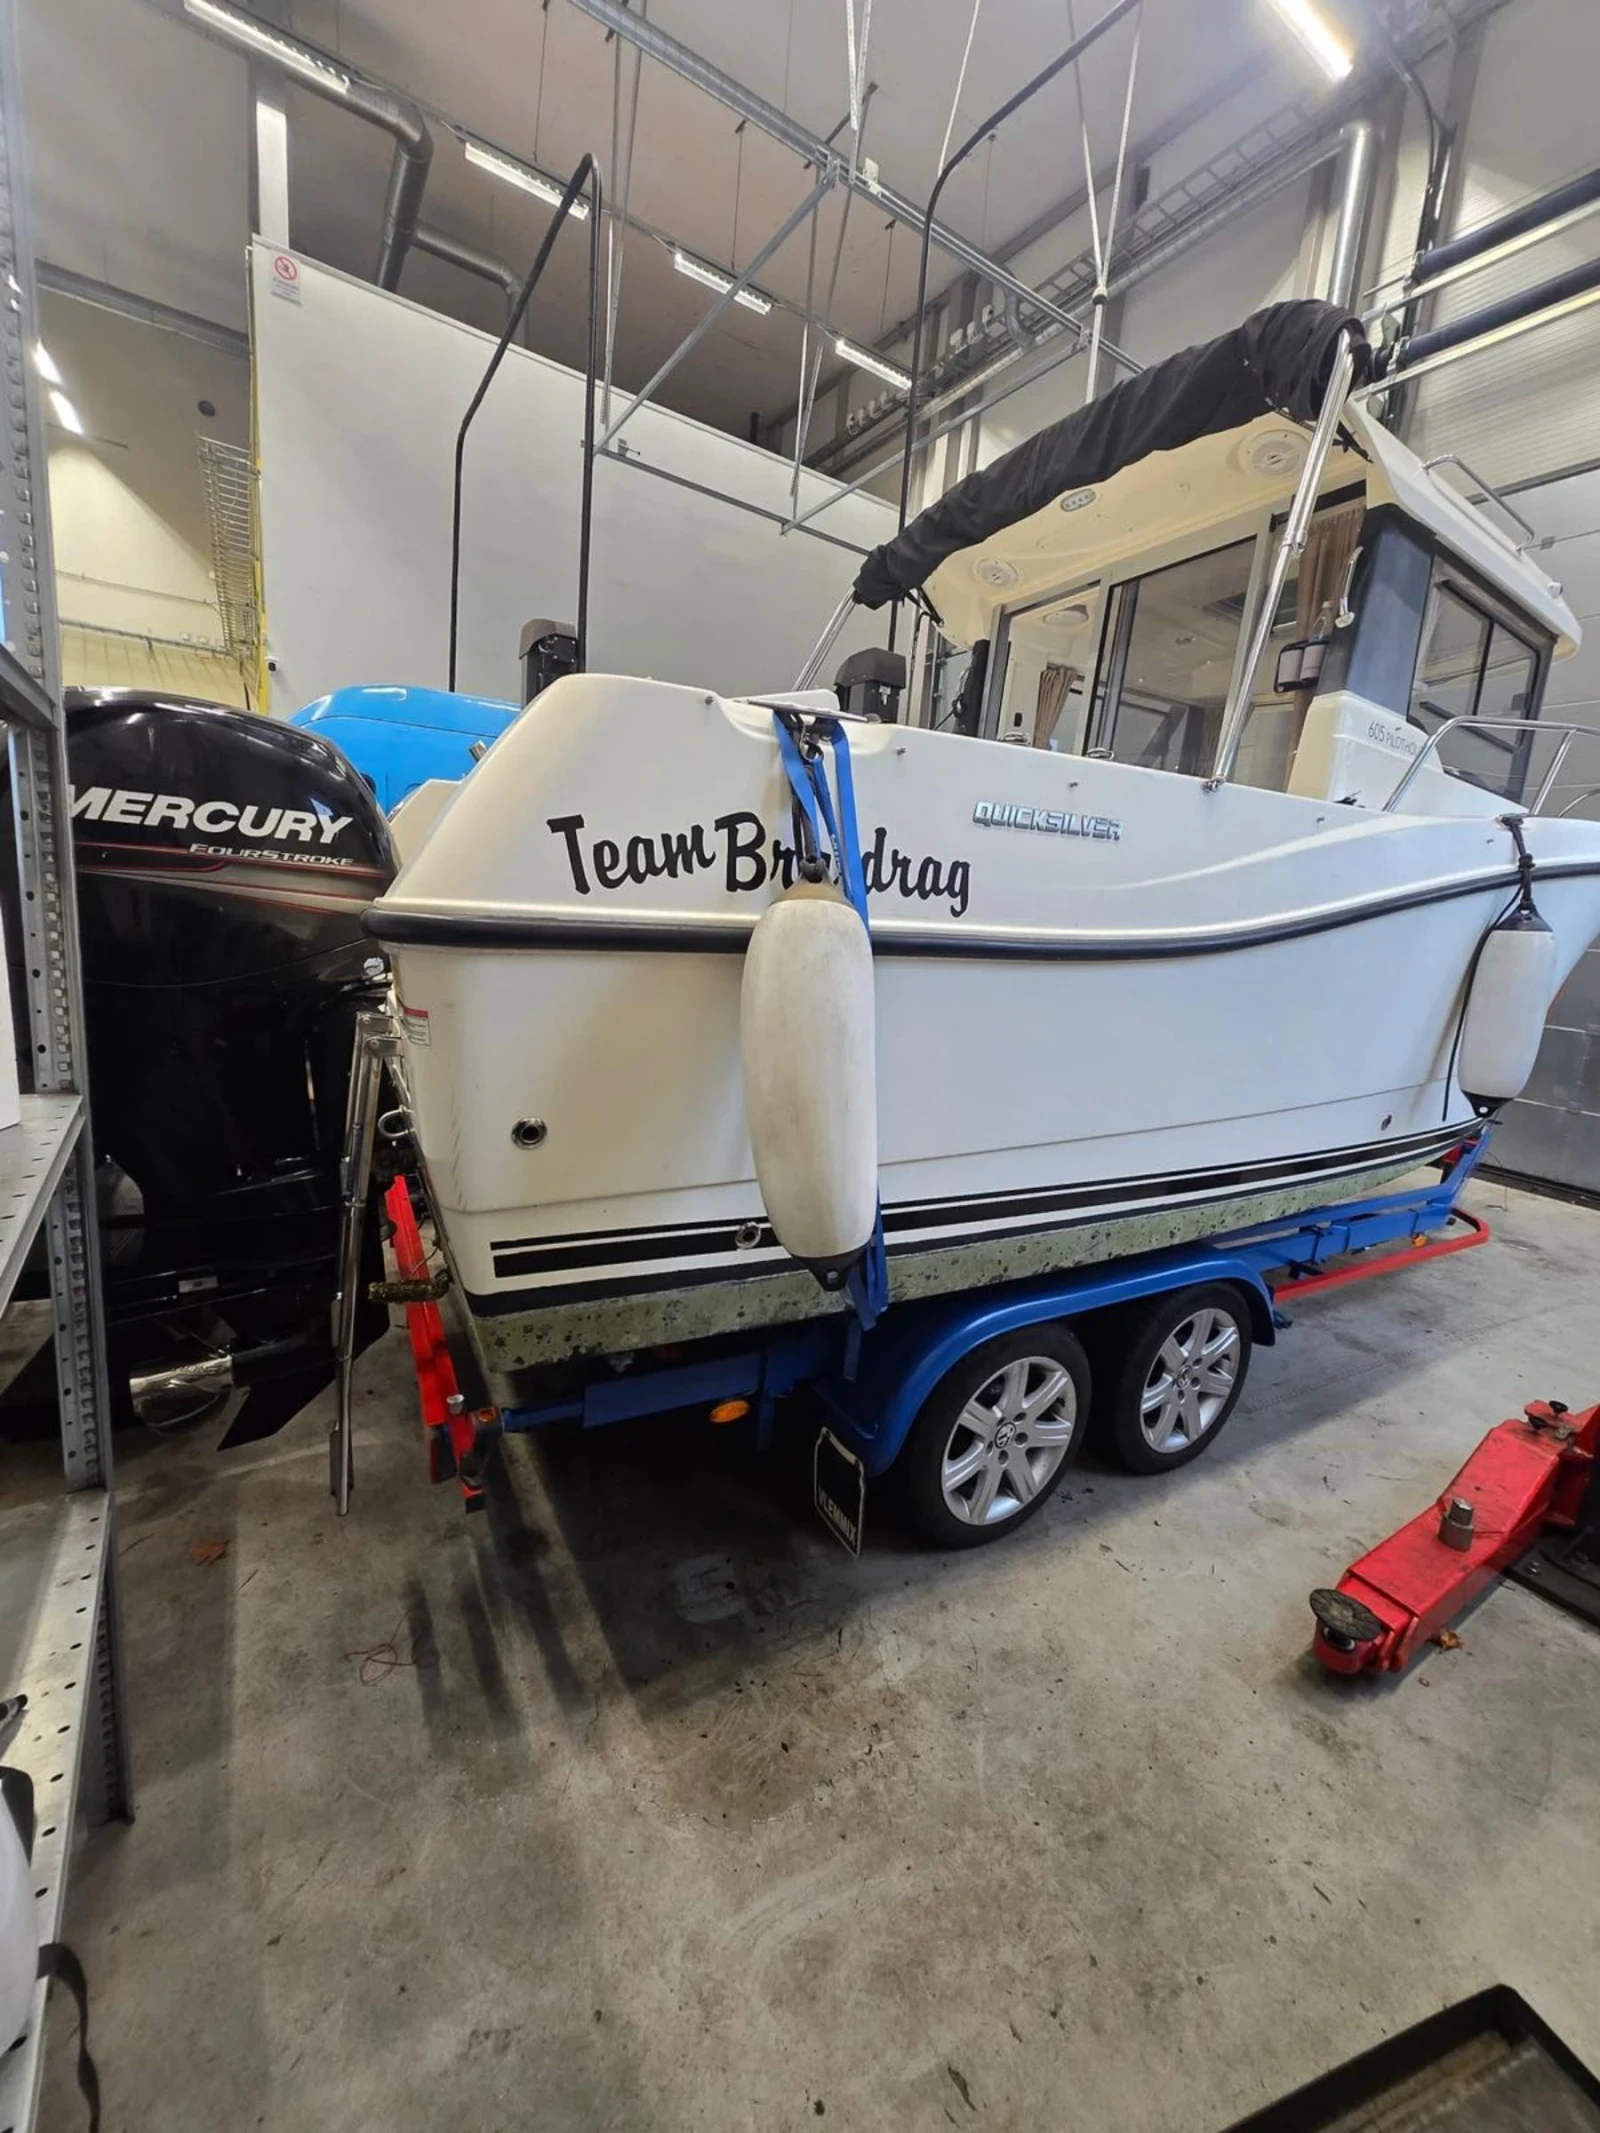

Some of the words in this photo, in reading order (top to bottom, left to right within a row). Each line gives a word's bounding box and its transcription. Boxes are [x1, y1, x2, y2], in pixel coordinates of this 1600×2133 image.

[1367, 720, 1385, 743] 605
[973, 801, 1124, 841] QUICKSILVER
[546, 814, 716, 894] Team
[714, 811, 971, 918] Brdrag
